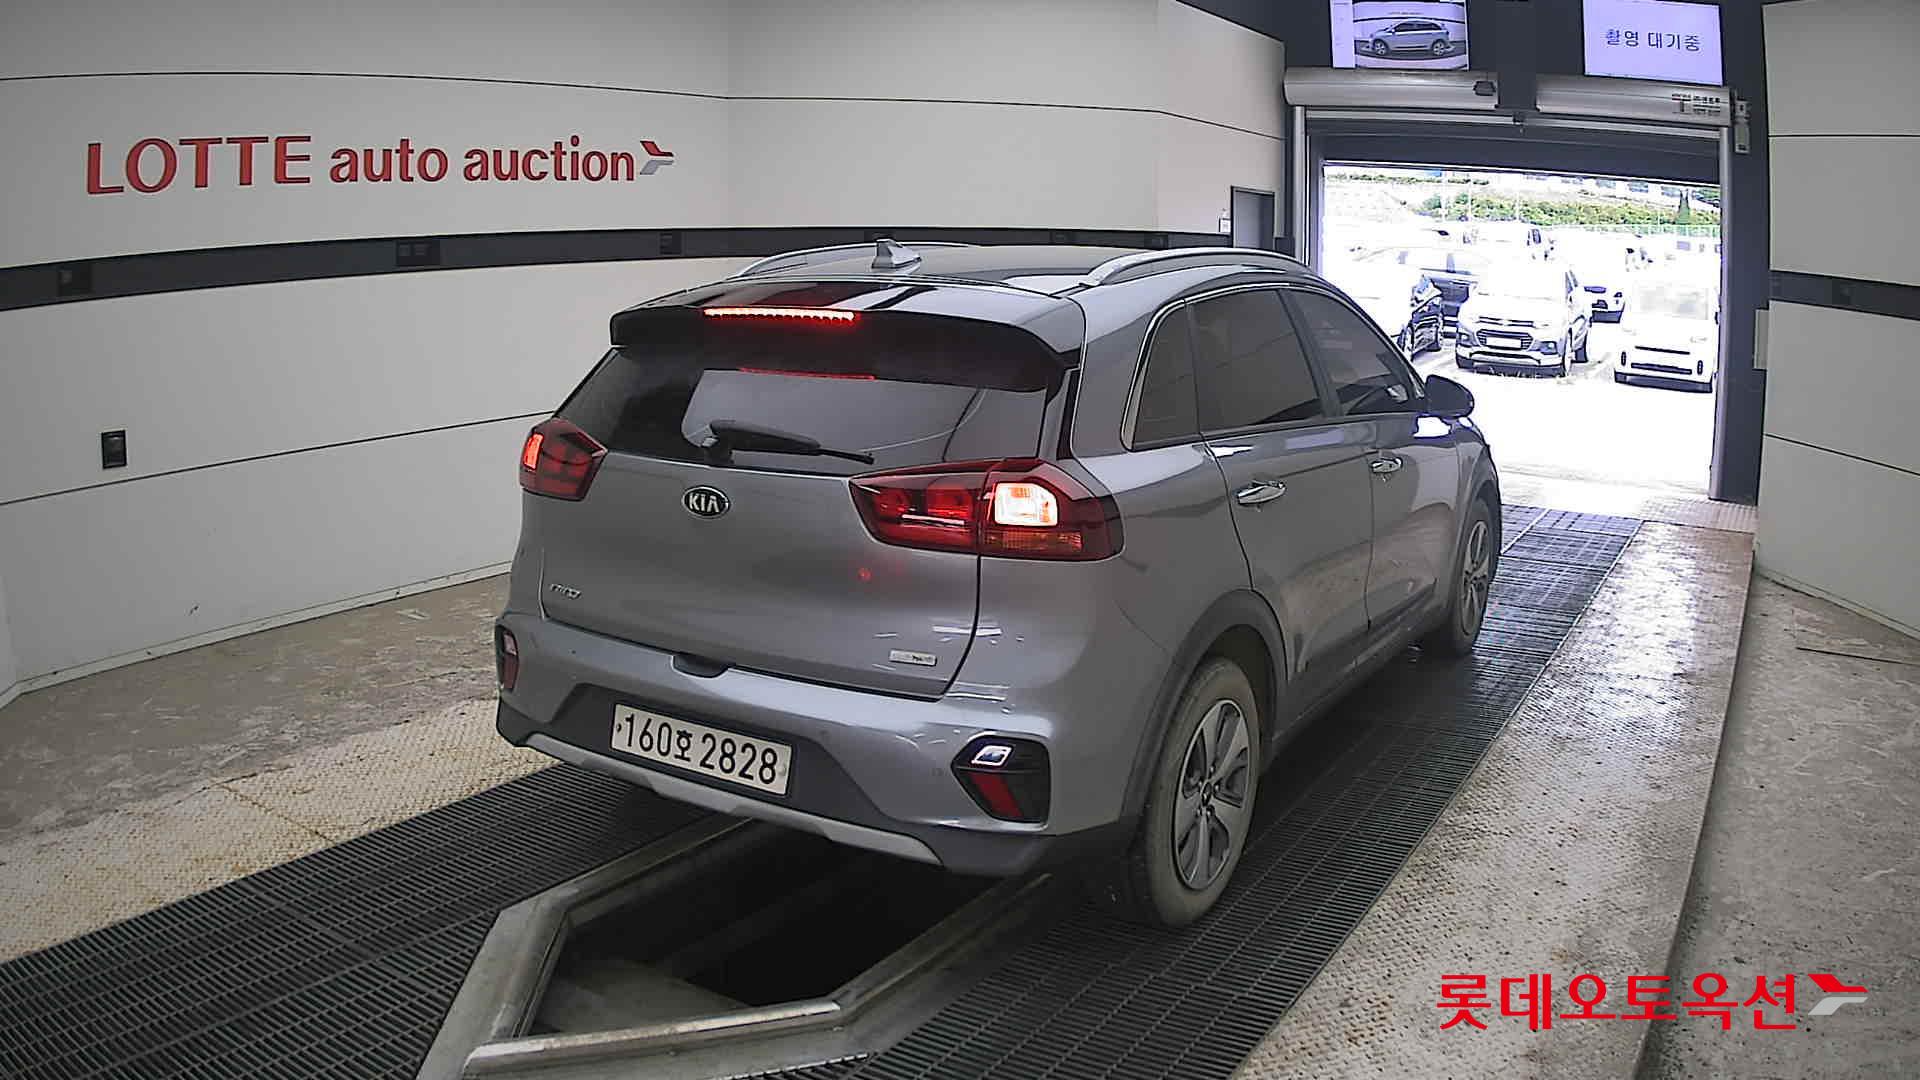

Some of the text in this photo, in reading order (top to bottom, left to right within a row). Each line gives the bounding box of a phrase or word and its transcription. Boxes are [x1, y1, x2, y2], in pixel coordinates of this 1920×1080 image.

[1647, 32, 1700, 51] 대기중
[87, 135, 634, 194] LOTTE auto auction
[689, 492, 720, 513] KIA
